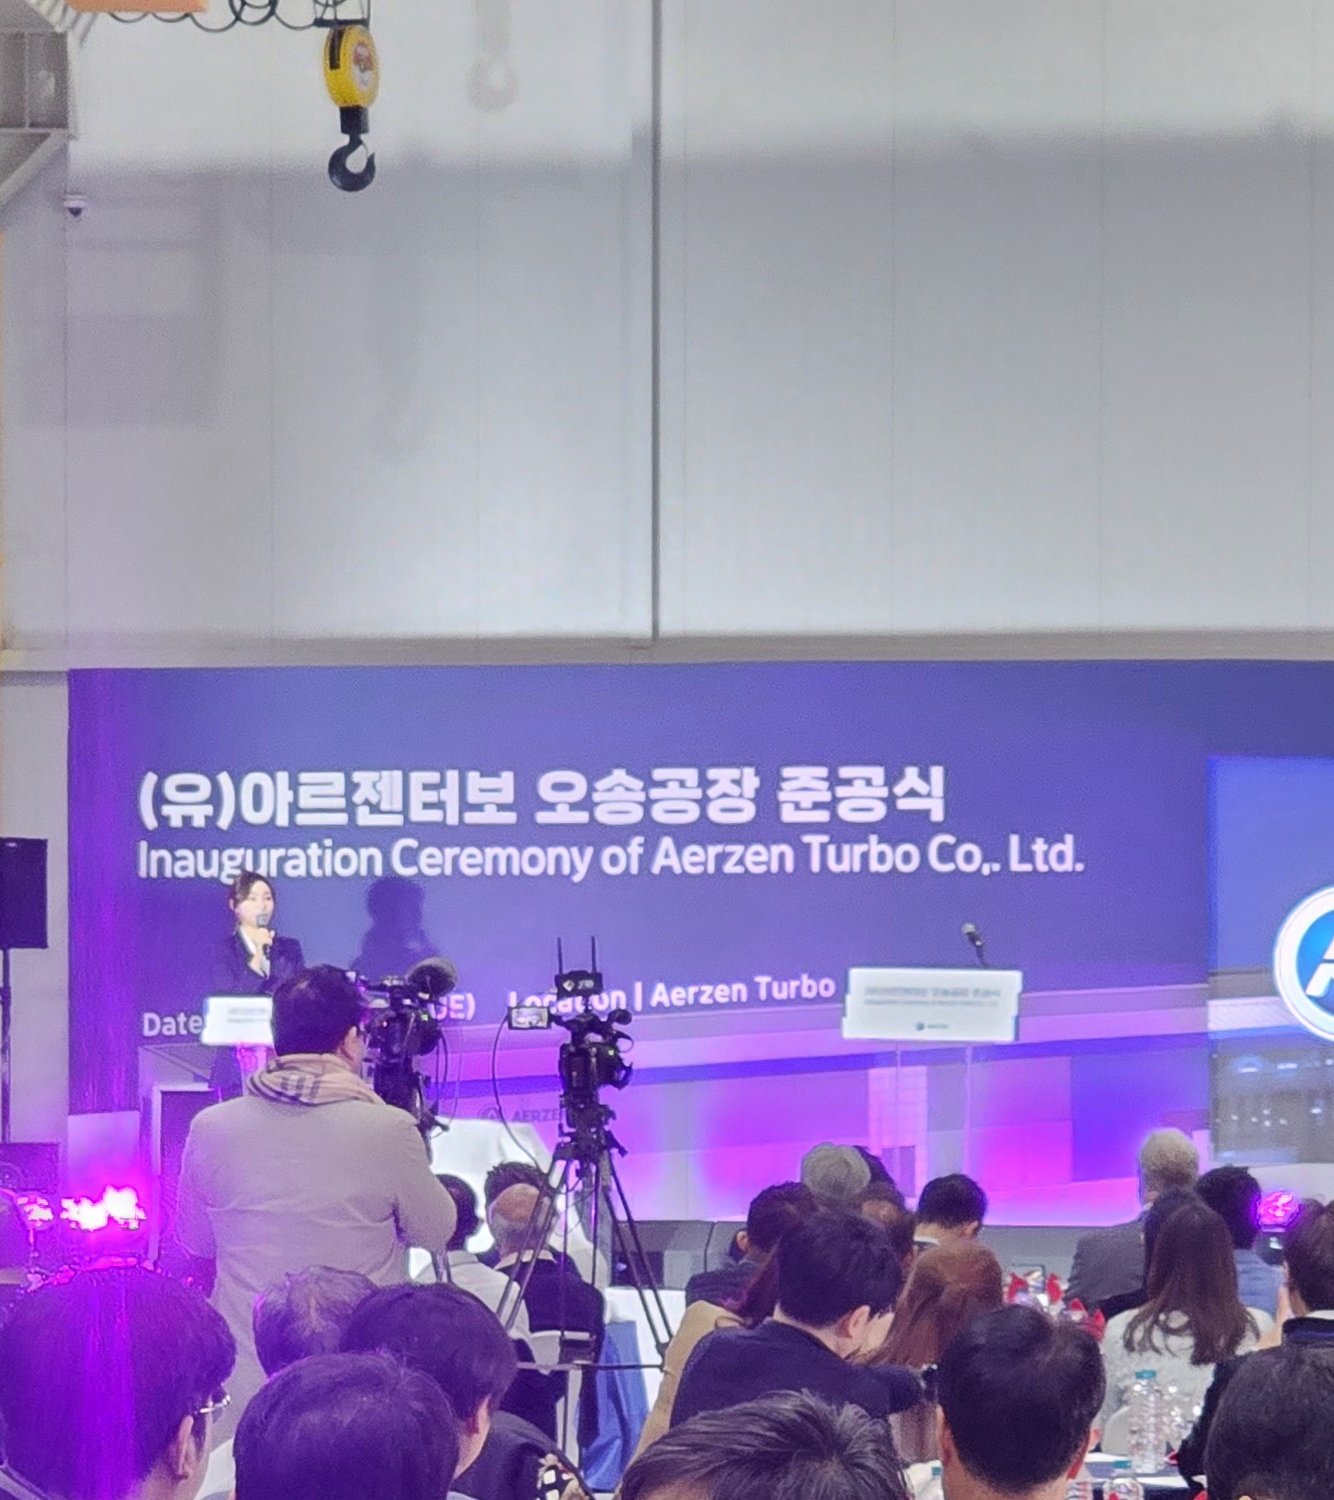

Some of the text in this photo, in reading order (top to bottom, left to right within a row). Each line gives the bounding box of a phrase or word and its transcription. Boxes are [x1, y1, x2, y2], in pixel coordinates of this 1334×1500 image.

[139, 765, 945, 831] (유)아르젠터보 오송공장 준공식
[139, 839, 383, 885] Inauguration
[392, 838, 594, 883] Ceremony
[601, 836, 645, 876] of
[651, 837, 794, 875] Aerzen
[801, 834, 921, 874] Turbo
[1009, 834, 1085, 874] Ltd.
[143, 1012, 204, 1037] Date
[650, 982, 748, 1008] Aerzen
[754, 973, 836, 1001] Turbo
[512, 1108, 561, 1123] AERZE
